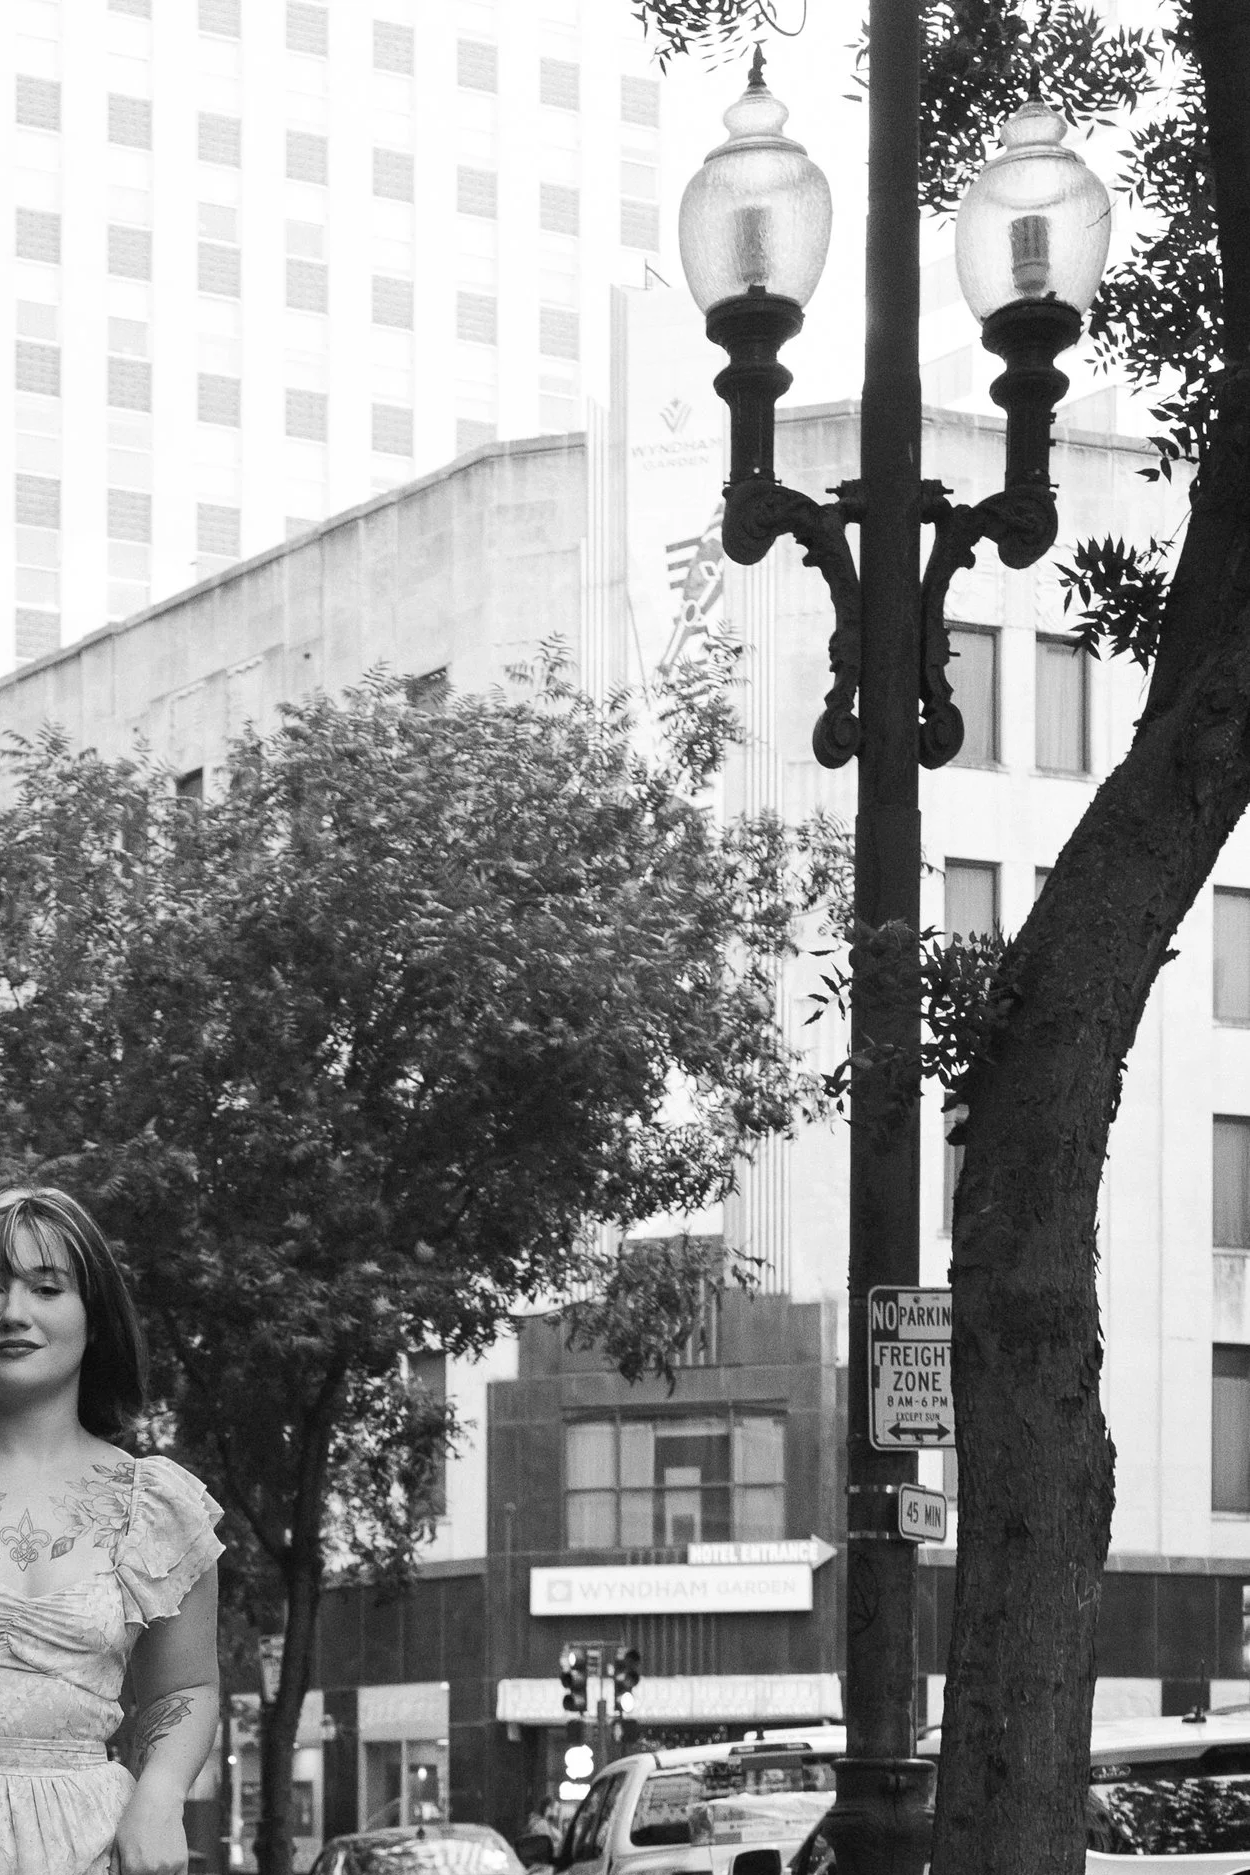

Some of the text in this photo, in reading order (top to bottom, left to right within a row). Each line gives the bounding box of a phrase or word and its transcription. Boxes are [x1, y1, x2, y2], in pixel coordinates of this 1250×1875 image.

[872, 1301, 951, 1331] NO PARKIN
[879, 1346, 951, 1367] FREIGH
[893, 1371, 942, 1392] ZONE
[887, 1395, 894, 1408] 8
[932, 1395, 948, 1408] PM
[896, 1412, 941, 1423] EXCEPT SUN
[907, 1501, 941, 1528] 45 MIN
[689, 1541, 819, 1564] HOTEL ENTRANCE
[579, 1578, 797, 1600] WYNDHAM GARDEN
